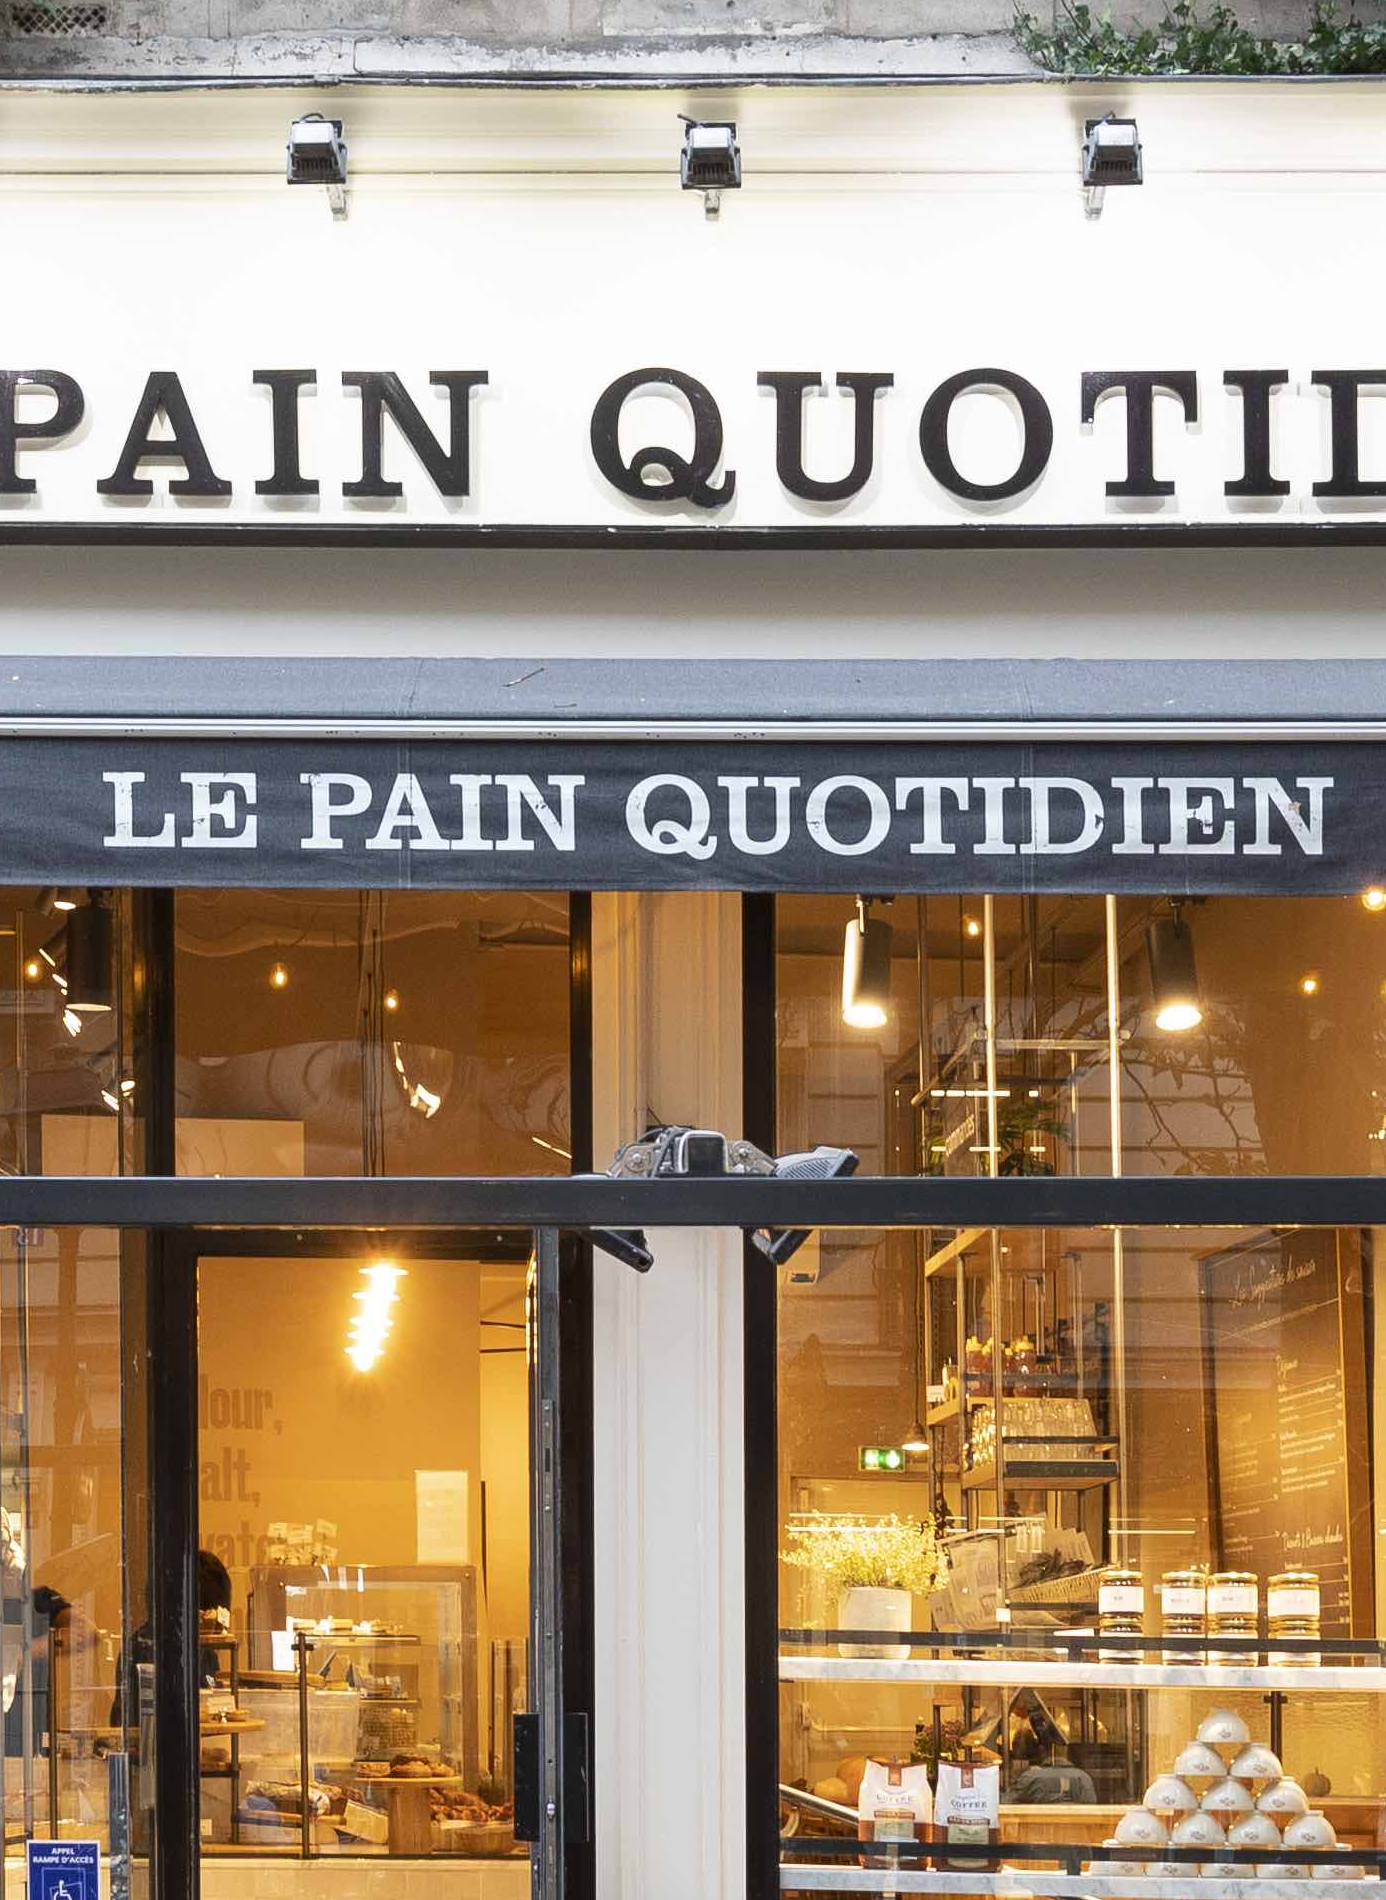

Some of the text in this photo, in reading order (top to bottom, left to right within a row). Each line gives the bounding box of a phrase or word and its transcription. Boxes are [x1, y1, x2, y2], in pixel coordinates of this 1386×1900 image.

[102, 771, 1334, 860] LE PAIN QUOTIDIEN
[51, 1847, 75, 1855] APPEL
[32, 1856, 59, 1864] RAMPE
